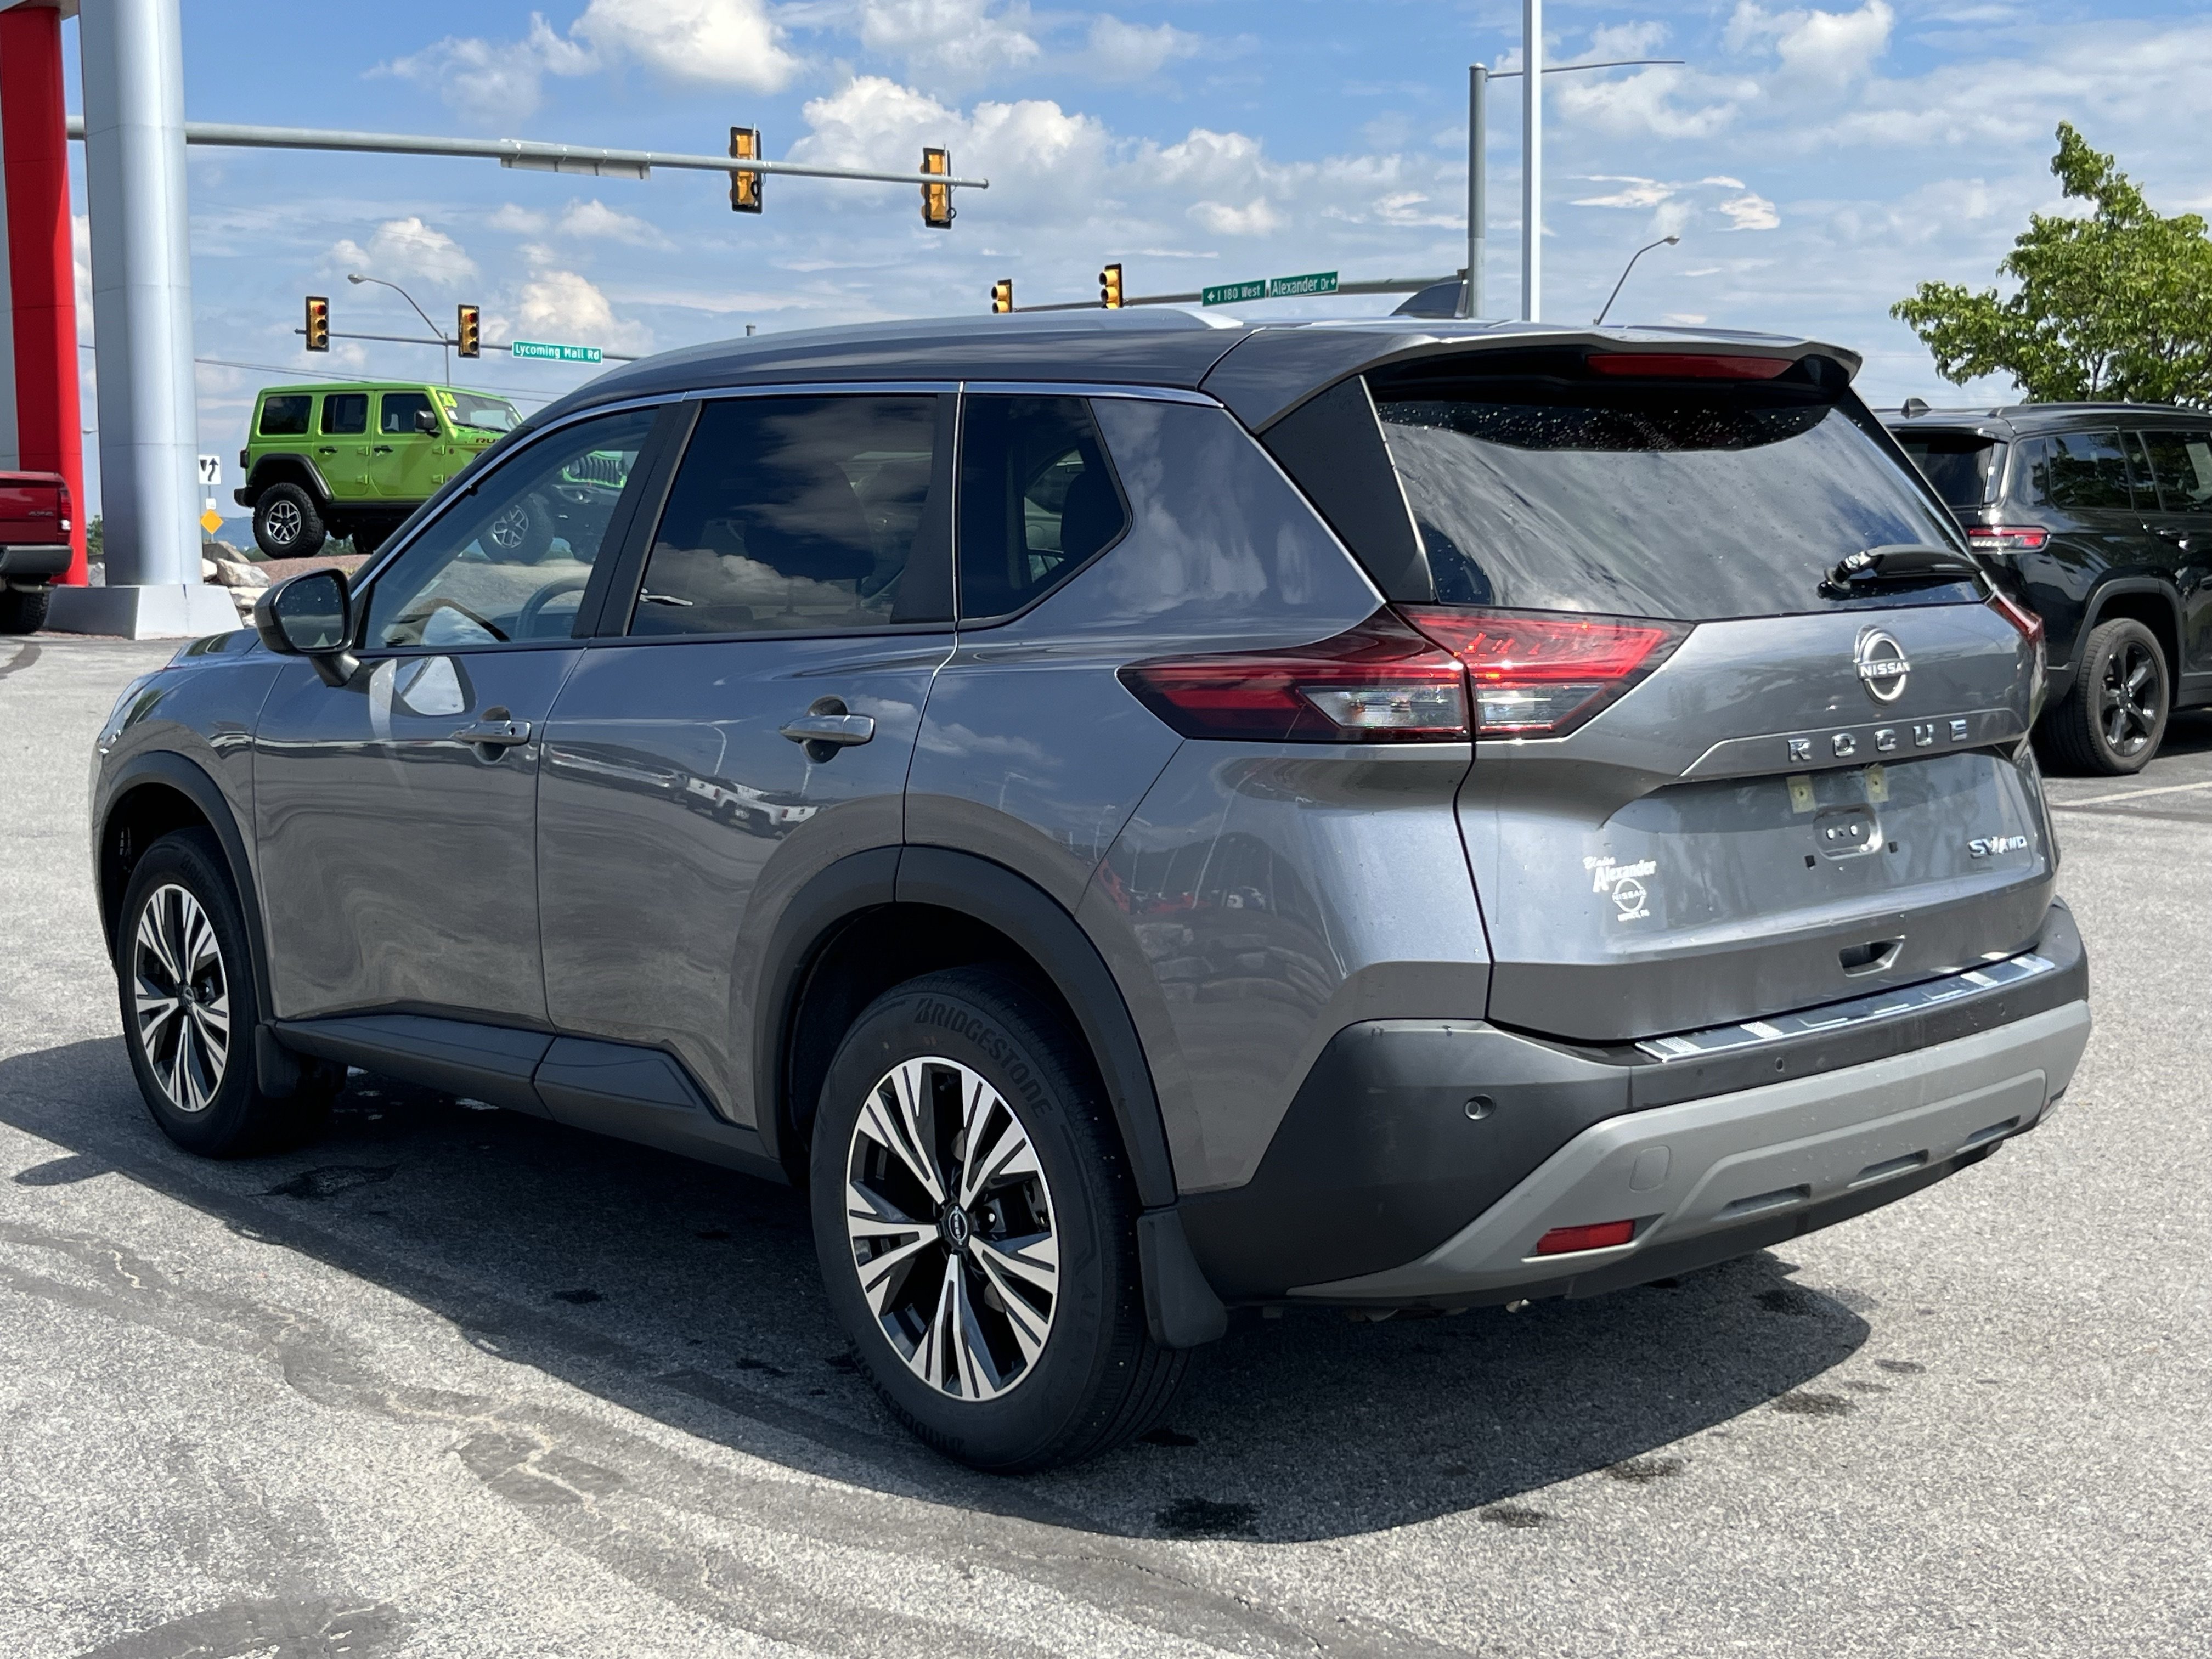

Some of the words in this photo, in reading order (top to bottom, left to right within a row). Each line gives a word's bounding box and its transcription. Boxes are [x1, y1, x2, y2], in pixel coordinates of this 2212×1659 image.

[1223, 289, 1238, 300] 180
[1241, 285, 1261, 297] West
[1272, 278, 1318, 296] Alexander
[1321, 278, 1329, 290] Dr
[515, 343, 560, 359] Lycoming
[564, 347, 584, 359] Mall
[588, 350, 600, 360] Rd
[1860, 661, 1910, 677] NISSAN
[1787, 719, 1968, 761] ROGUE
[1593, 859, 1656, 893] Alexander
[1612, 889, 1646, 902] NISSAN
[913, 997, 1053, 1119] BRIDGESTONE
